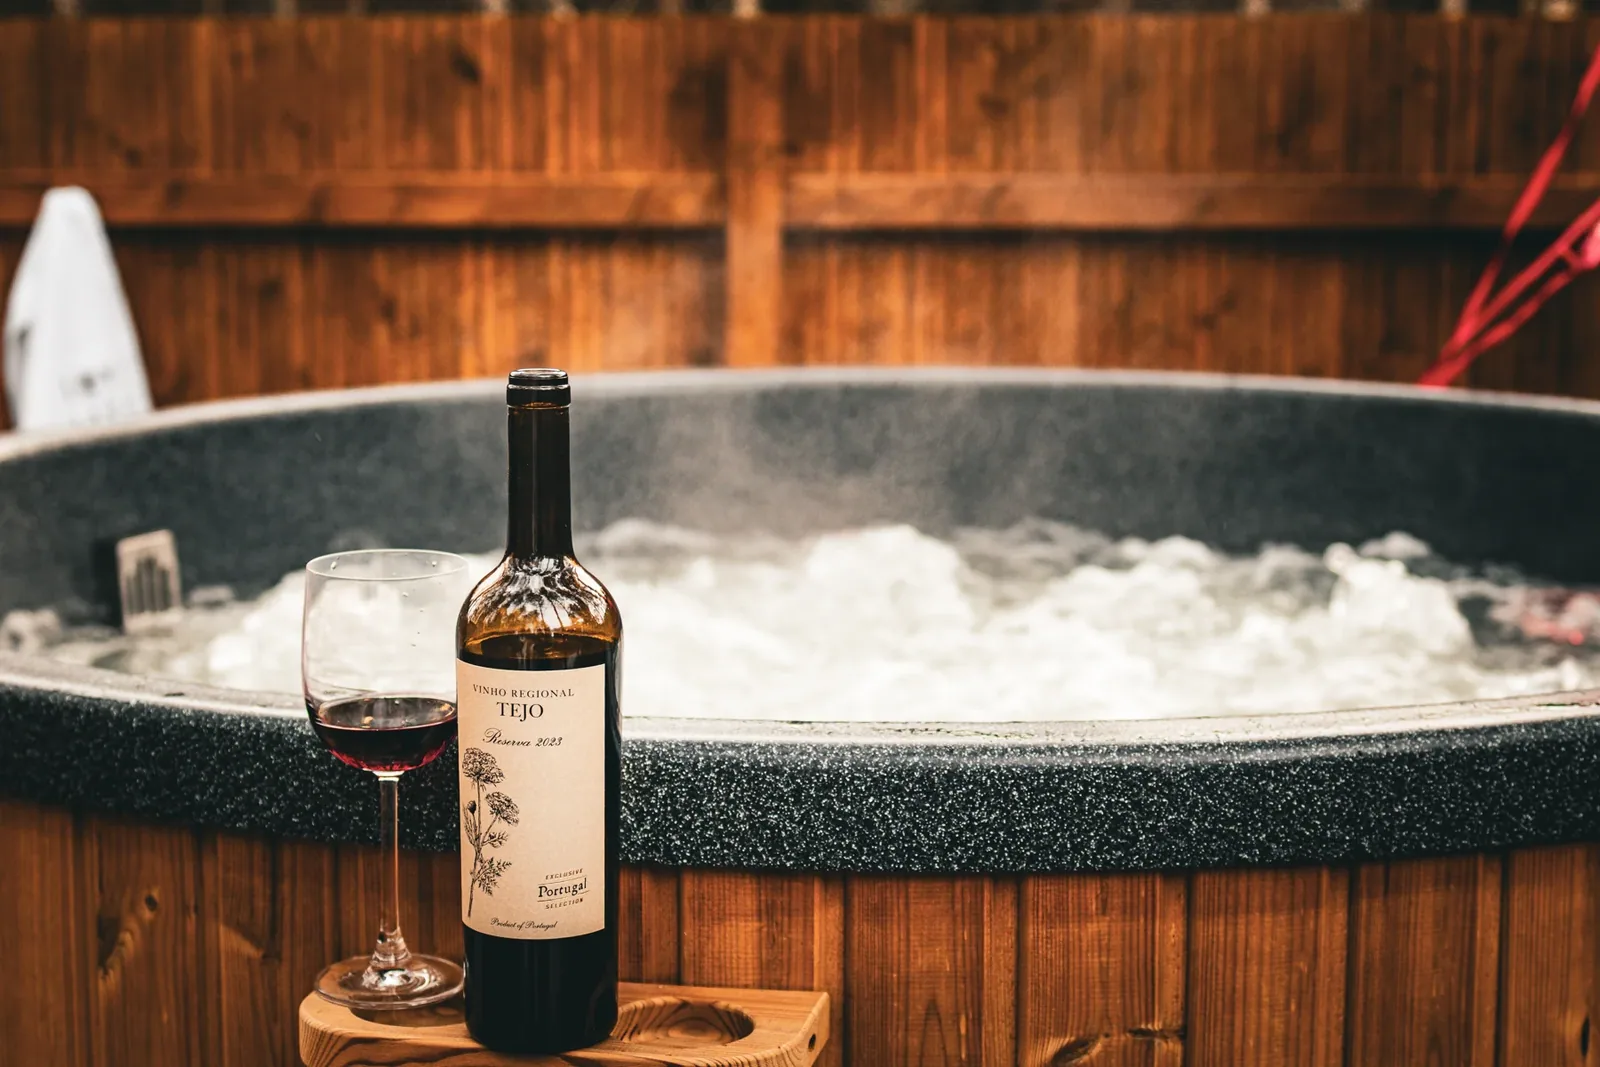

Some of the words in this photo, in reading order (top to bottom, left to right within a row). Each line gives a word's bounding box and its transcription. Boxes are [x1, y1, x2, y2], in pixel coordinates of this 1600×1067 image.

[472, 684, 507, 697] VINHO
[511, 688, 575, 698] REGIONAL
[496, 701, 544, 722] TEJO
[482, 727, 531, 747] Reserva
[535, 736, 563, 747] 2023
[545, 868, 583, 879] EXCLUSIVE
[538, 877, 587, 898] Portugal
[545, 897, 583, 909] SELECTION
[490, 917, 516, 928] Product
[516, 921, 524, 930] of
[525, 920, 557, 931] Portugal
